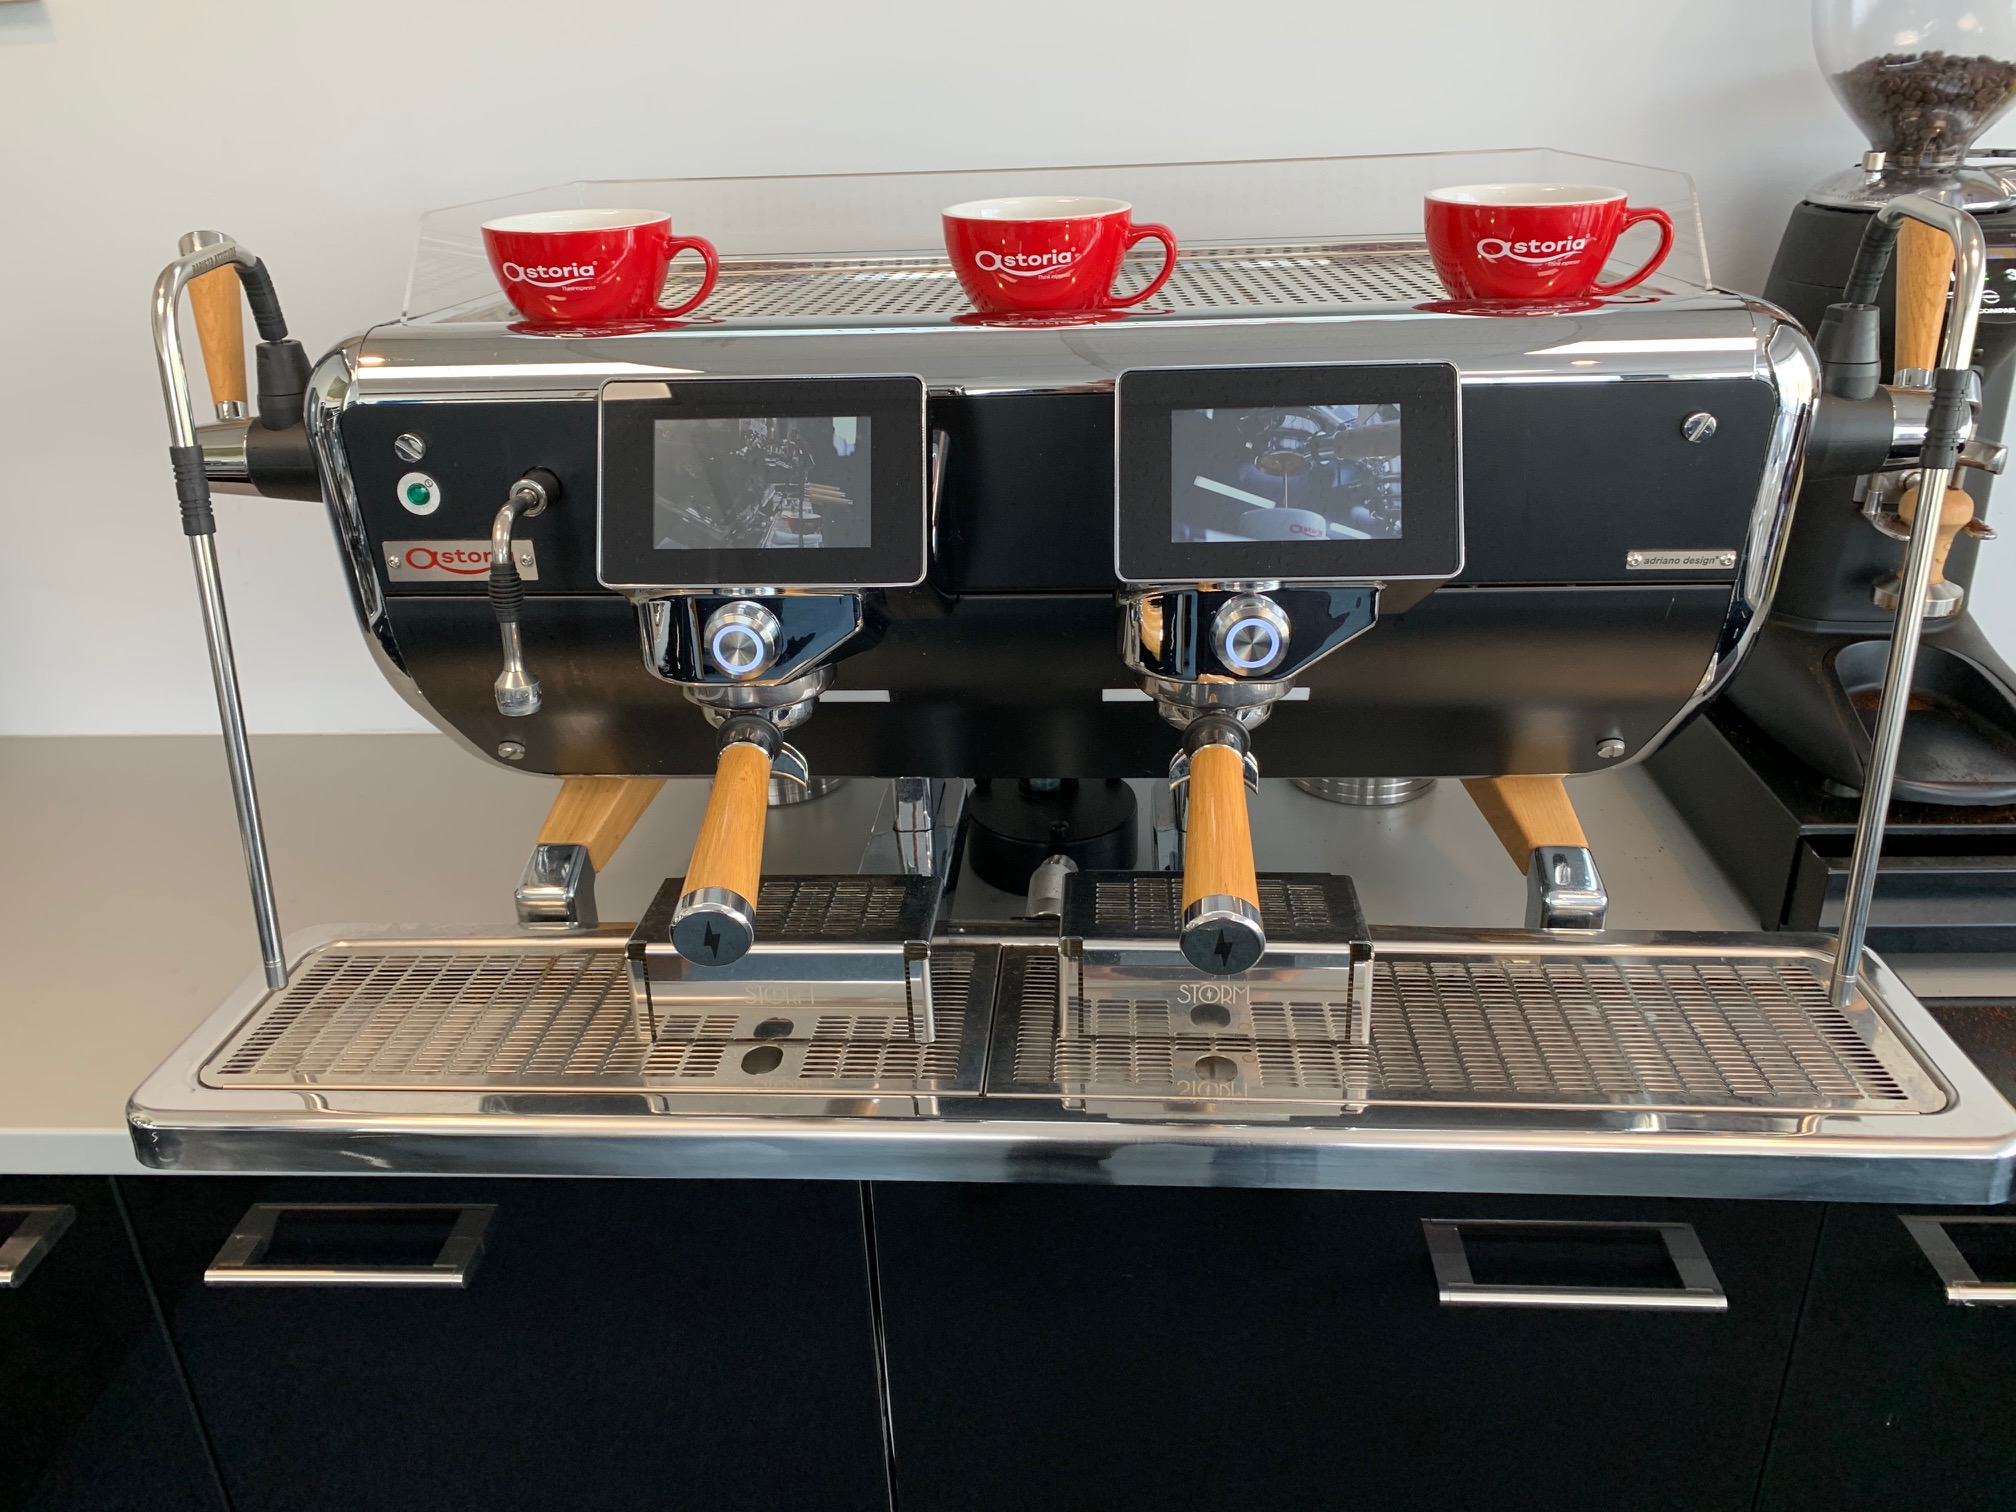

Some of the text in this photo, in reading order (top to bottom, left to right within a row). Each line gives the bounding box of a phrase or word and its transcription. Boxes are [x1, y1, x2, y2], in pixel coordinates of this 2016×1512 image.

[405, 547, 514, 574] astor
[1643, 556, 1680, 565] adriano
[1177, 984, 1251, 1005] STORM
